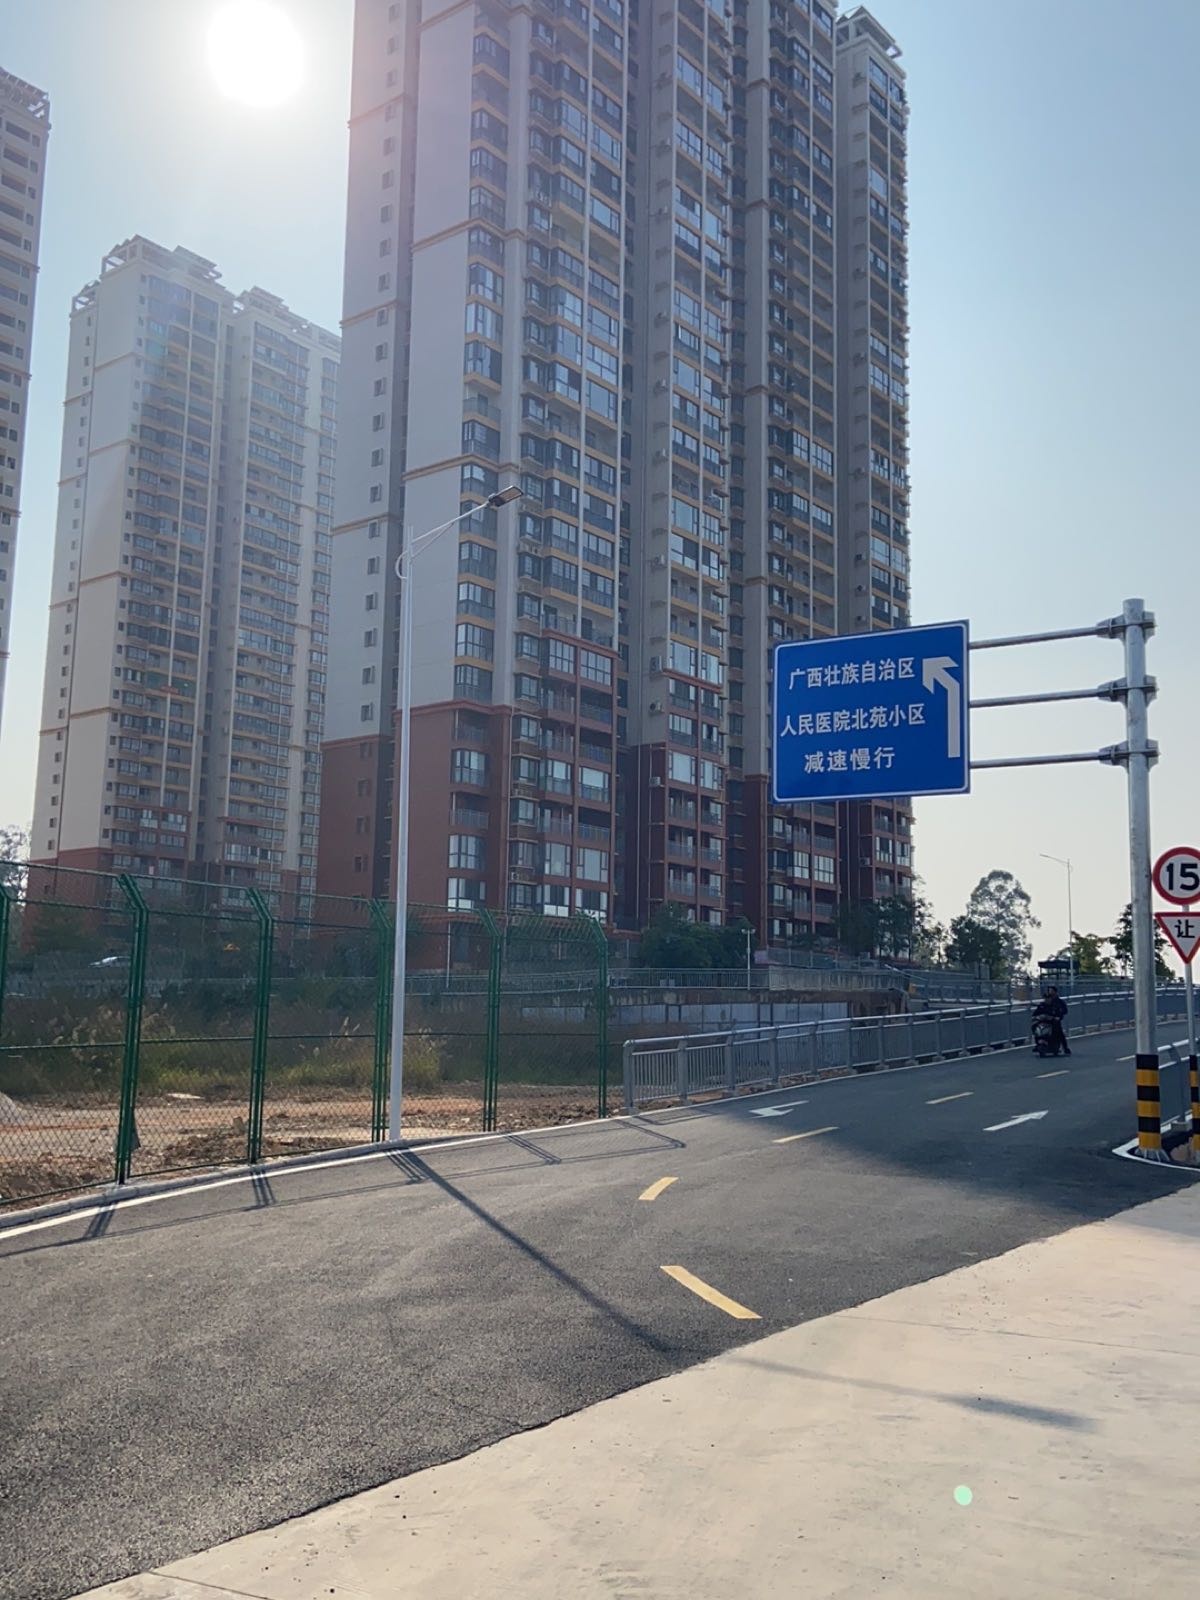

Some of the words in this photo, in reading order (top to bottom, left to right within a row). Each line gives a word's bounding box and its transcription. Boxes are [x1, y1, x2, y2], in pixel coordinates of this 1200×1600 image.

[789, 657, 915, 690] 广西壮族自治区
[780, 703, 926, 737] 人民医院北苑小区
[804, 747, 895, 774] 减速慢行
[1166, 863, 1200, 891] 15
[1174, 919, 1195, 938] 让
